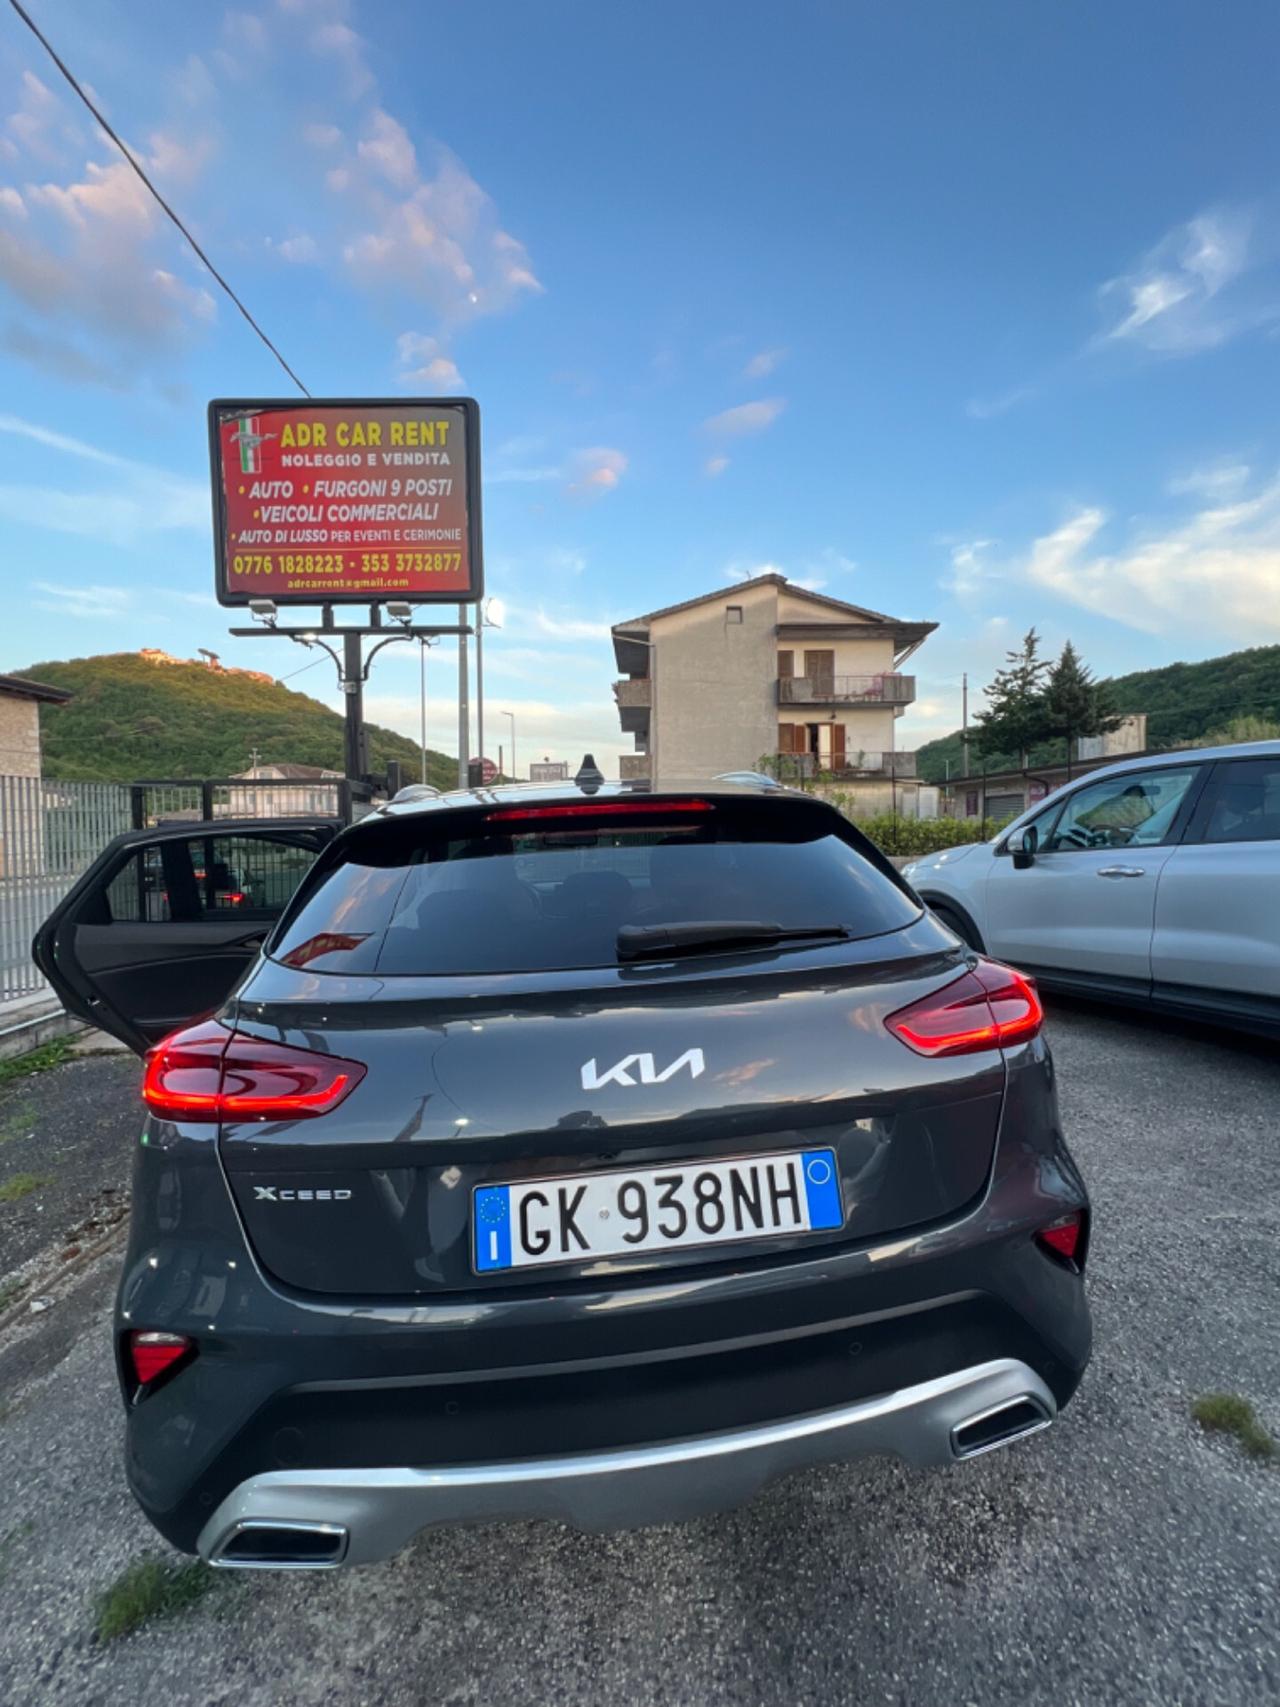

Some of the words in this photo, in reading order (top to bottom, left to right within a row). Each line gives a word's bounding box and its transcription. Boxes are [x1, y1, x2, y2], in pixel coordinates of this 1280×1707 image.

[281, 422, 327, 447] ADR
[336, 421, 381, 447] CAR
[390, 421, 449, 446] RENT
[281, 452, 361, 467] NOLEGGIO
[367, 453, 377, 466] E
[382, 451, 450, 466] VENDITA
[248, 481, 293, 499] AUTO
[313, 480, 387, 498] FURGONI
[391, 478, 401, 496] 9
[405, 478, 452, 496] POSTI
[260, 505, 324, 523] VEICOLI
[327, 503, 439, 522] COMMERCIALI
[238, 529, 272, 543] AUTO
[275, 530, 288, 543] DI
[290, 529, 328, 543] LUSSO
[331, 530, 351, 541] PER
[353, 529, 392, 542] EVENTI
[394, 529, 401, 541] E
[403, 528, 462, 541] CERIMONIE
[233, 555, 273, 575] 0776
[278, 554, 344, 574] 1828223
[361, 553, 390, 573] 353
[395, 552, 462, 572] 3732877
[519, 1185, 591, 1256] GK
[617, 1162, 802, 1244] 938NH
